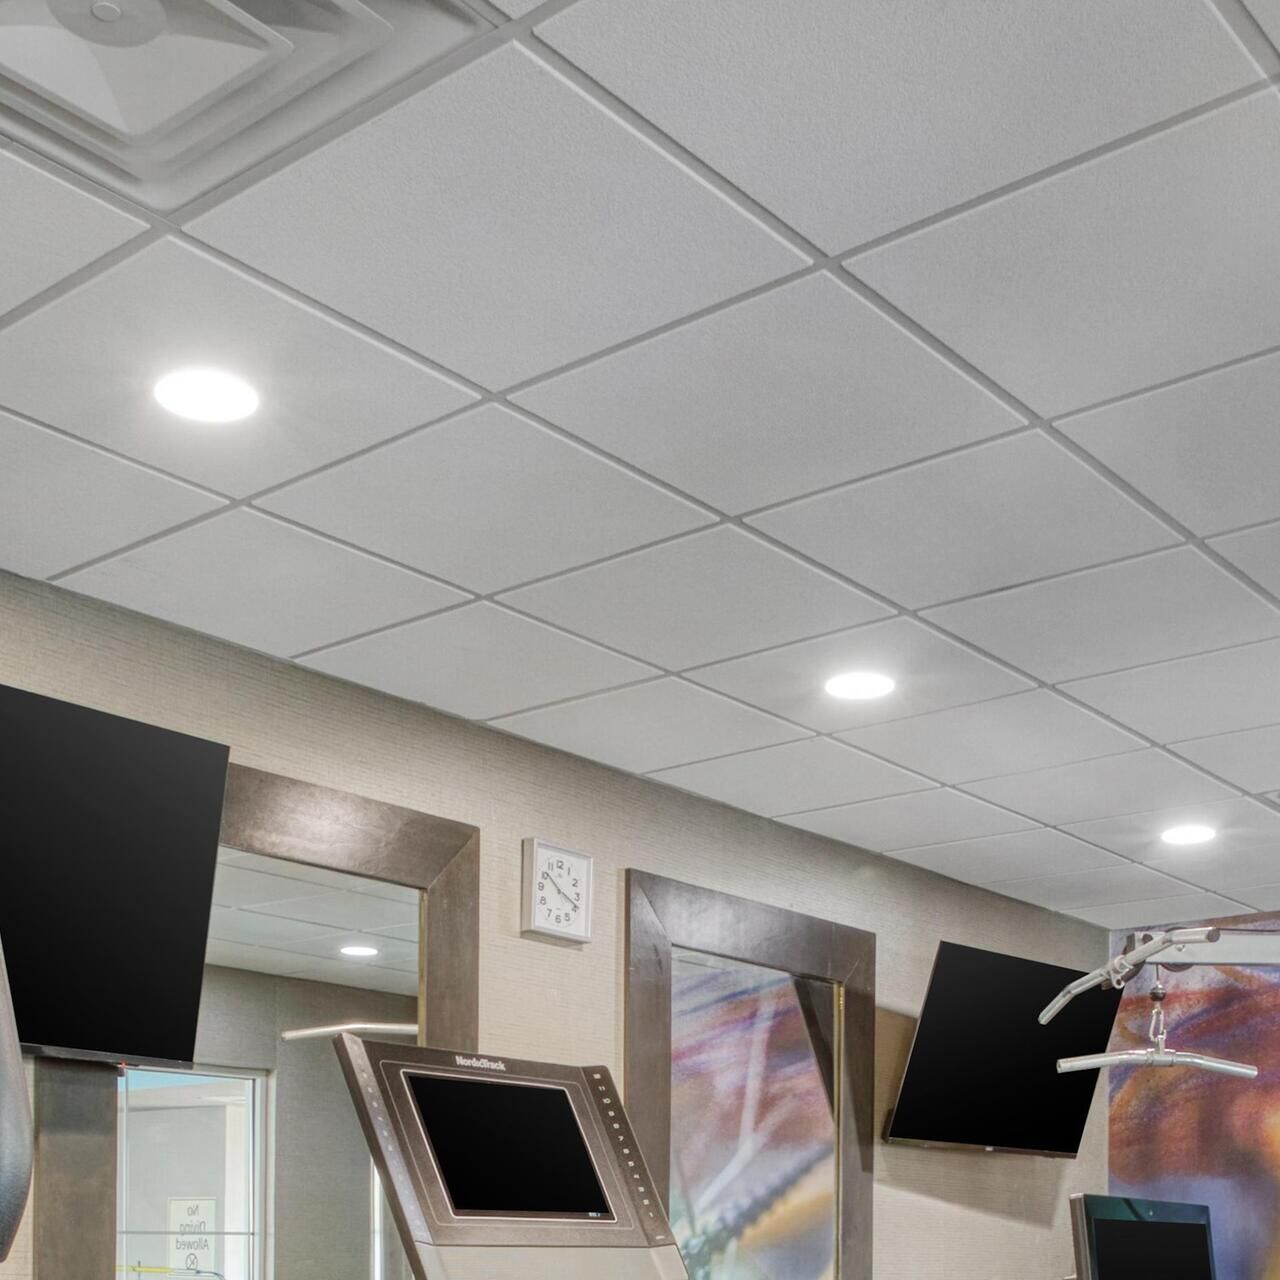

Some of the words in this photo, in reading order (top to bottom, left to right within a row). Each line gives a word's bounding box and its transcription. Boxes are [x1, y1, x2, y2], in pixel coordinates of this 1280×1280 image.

[548, 862, 554, 872] 11
[556, 860, 564, 870] 12
[568, 867, 571, 876] 1
[538, 882, 544, 891] 9
[572, 878, 578, 888] 2
[540, 896, 547, 905] 8
[574, 892, 580, 902] 3
[546, 908, 552, 918] 7
[564, 913, 571, 922] 5
[555, 914, 561, 923] 6
[455, 1055, 506, 1071] NordicTrack
